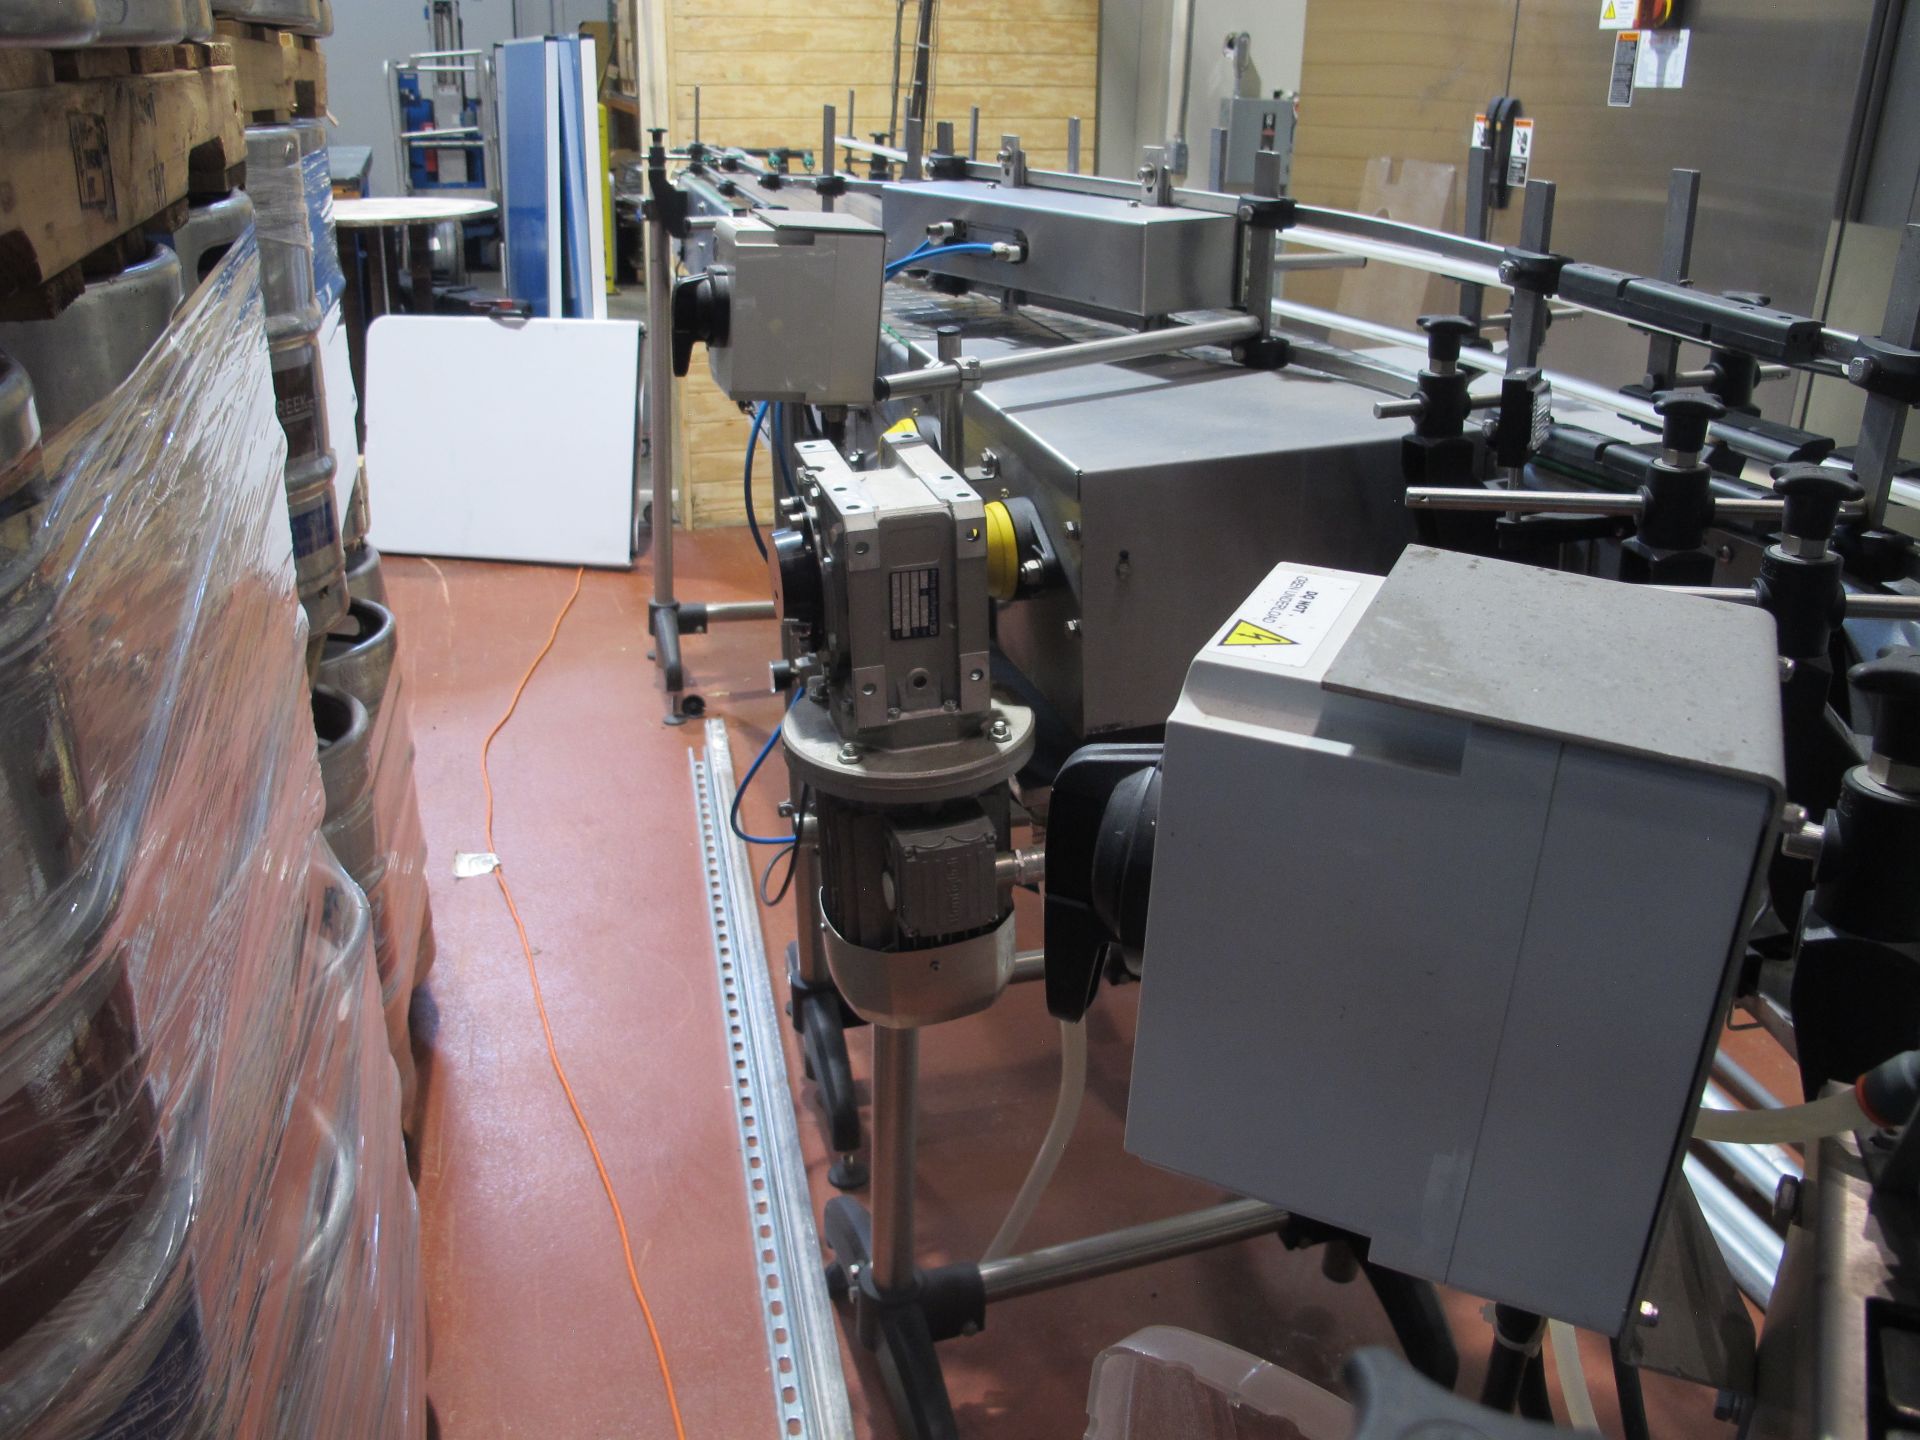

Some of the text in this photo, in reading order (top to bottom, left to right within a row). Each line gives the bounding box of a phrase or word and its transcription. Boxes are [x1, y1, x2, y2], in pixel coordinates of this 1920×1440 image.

[1288, 575, 1309, 592] OPEN
[1292, 590, 1319, 614] DO NOT
